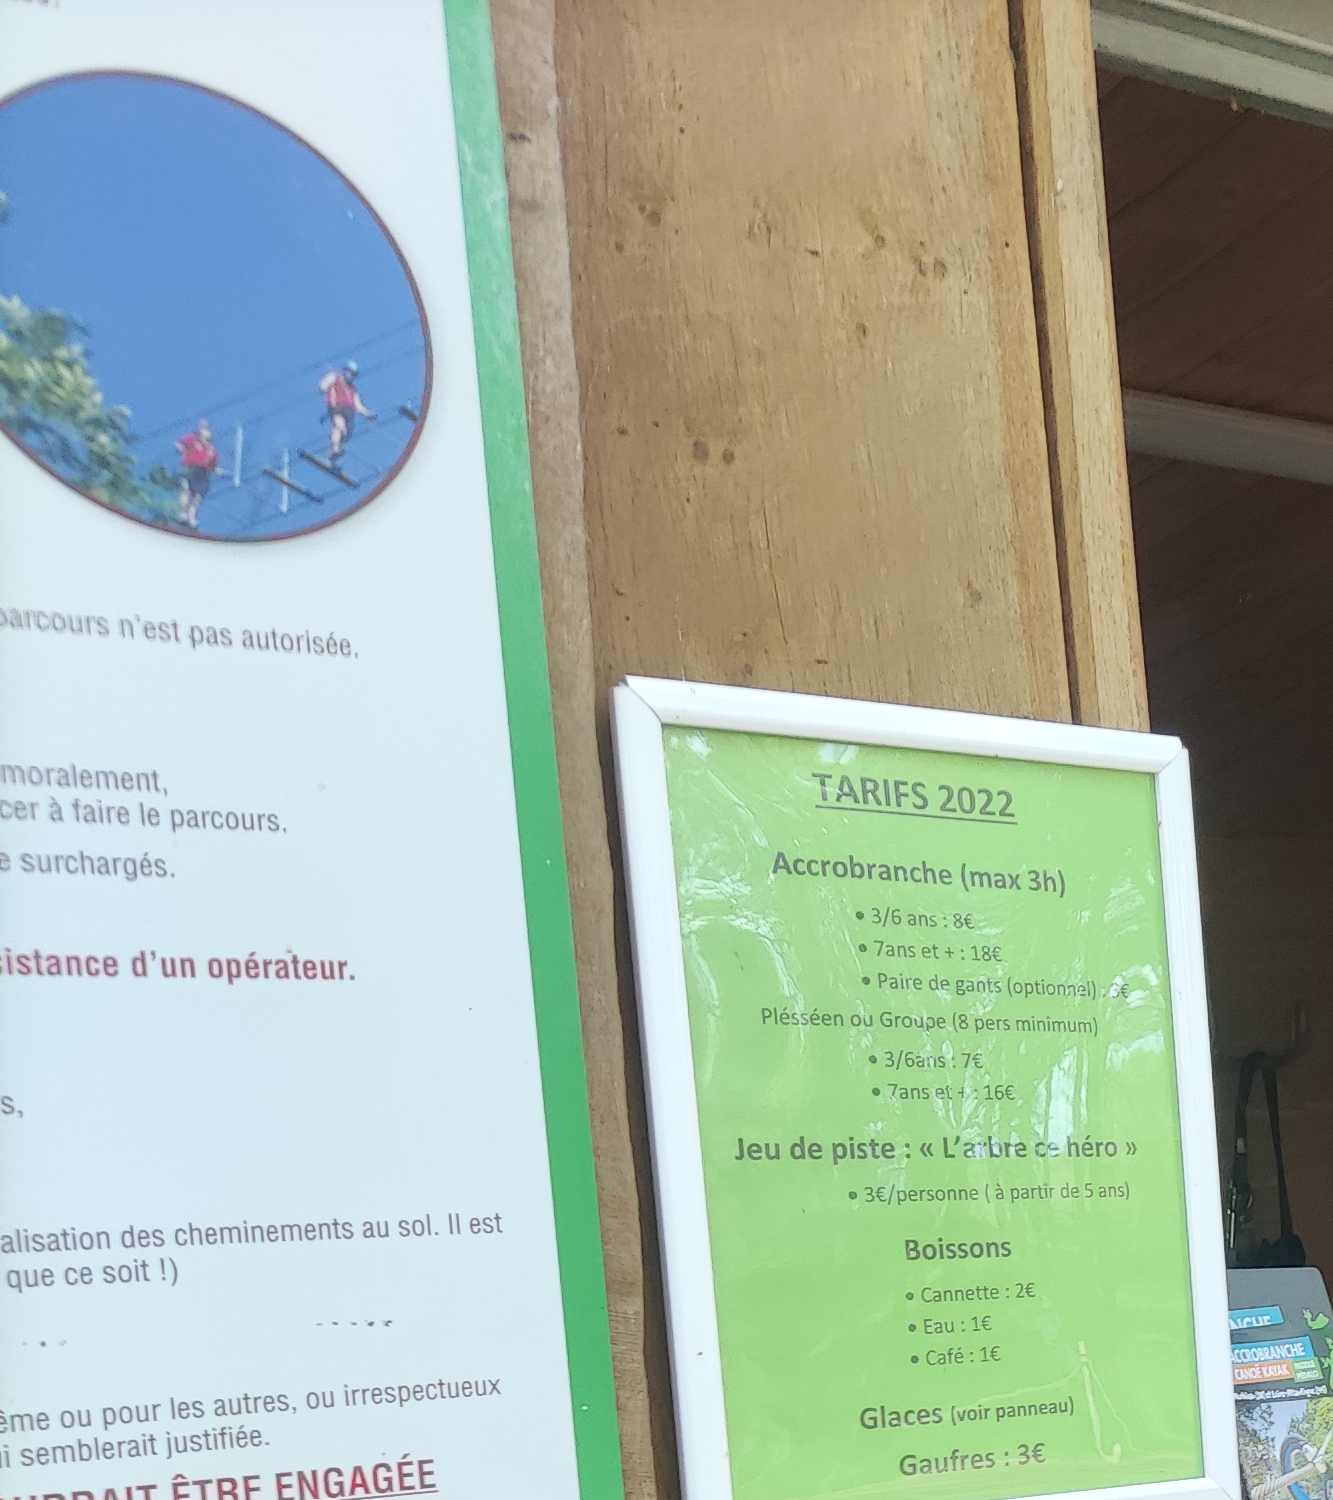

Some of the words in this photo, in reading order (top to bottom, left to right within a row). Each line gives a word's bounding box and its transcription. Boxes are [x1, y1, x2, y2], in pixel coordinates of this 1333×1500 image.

[119, 614, 181, 643] n'est
[188, 623, 233, 649] pas
[242, 627, 359, 659] autorisée.
[0, 763, 168, 796] moralement,
[812, 773, 929, 811] TARIFS
[939, 785, 1016, 818] 2022
[49, 796, 64, 822] à
[72, 798, 130, 827] faire
[139, 801, 161, 827] le
[171, 807, 287, 833] parcours.
[20, 849, 175, 881] surchargés.
[772, 852, 953, 886] Accrobranche
[960, 863, 1022, 892] (max
[1028, 868, 1066, 897] 3h)
[871, 908, 902, 928] 3/6
[907, 913, 937, 928] ans
[953, 914, 975, 930] 8€
[0, 947, 119, 977] istance
[132, 950, 197, 979] d'un
[208, 951, 356, 985] opérateur.
[874, 941, 917, 960] 7ans
[922, 942, 941, 960] et
[945, 947, 955, 958] +
[972, 944, 1003, 963] 18€
[877, 972, 924, 992] Paire
[929, 974, 952, 992] de
[956, 975, 1002, 997] gants
[1007, 976, 1097, 1001] (optionnel)
[761, 1008, 844, 1030] Plésséen
[850, 1014, 874, 1030] ou
[879, 1011, 946, 1034] Groupe
[952, 1014, 968, 1033] (8
[973, 1016, 1010, 1035] pers
[1015, 1016, 1098, 1037] minimum)
[884, 1051, 946, 1071] 3/6ans
[961, 1052, 983, 1069] 7€
[888, 1083, 929, 1101] 7ans
[934, 1085, 953, 1101] et
[984, 1084, 1015, 1102] 16€
[734, 1137, 782, 1162] Jeu
[789, 1138, 823, 1160] de
[832, 1137, 896, 1166] piste
[920, 1142, 934, 1157] «
[943, 1136, 1027, 1159] L'arbre
[1066, 1135, 1117, 1158] héro
[1126, 1141, 1137, 1156] »
[864, 1181, 978, 1206] 3€/personne
[995, 1183, 1004, 1200] à
[1010, 1183, 1055, 1204] partir
[1061, 1183, 1079, 1198] de
[1085, 1183, 1093, 1198] 5
[1098, 1181, 1129, 1201] ans)
[0, 1226, 111, 1254] alisation
[121, 1221, 165, 1248] des
[174, 1217, 354, 1247] cheminements
[362, 1220, 390, 1240] au
[399, 1214, 438, 1237] sol.
[448, 1213, 461, 1235] Il
[469, 1213, 503, 1235] est
[905, 1238, 1012, 1261] Boissons
[7, 1267, 55, 1293] que
[64, 1266, 94, 1286] ce
[103, 1260, 150, 1283] soit
[921, 1283, 1000, 1303] Cannette
[1015, 1283, 1036, 1299] 2€
[924, 1319, 955, 1336] Eau
[971, 1316, 992, 1333] 1€
[926, 1347, 964, 1366] Café
[980, 1346, 1001, 1363] 1€
[1263, 1363, 1290, 1377] KAYAK
[60, 1408, 92, 1430] ou
[103, 1402, 160, 1431] pour
[170, 1397, 205, 1421] les
[214, 1391, 298, 1418] autres,
[307, 1388, 335, 1410] ou
[344, 1377, 501, 1408] irrespectueux
[860, 1404, 943, 1431] Glaces
[950, 1404, 990, 1427] (voir
[996, 1397, 1075, 1422] panneau)
[20, 1433, 158, 1467] semblerait
[166, 1427, 270, 1459] justifiée.
[900, 1449, 996, 1477] Gaufres
[1018, 1444, 1046, 1466] 3€
